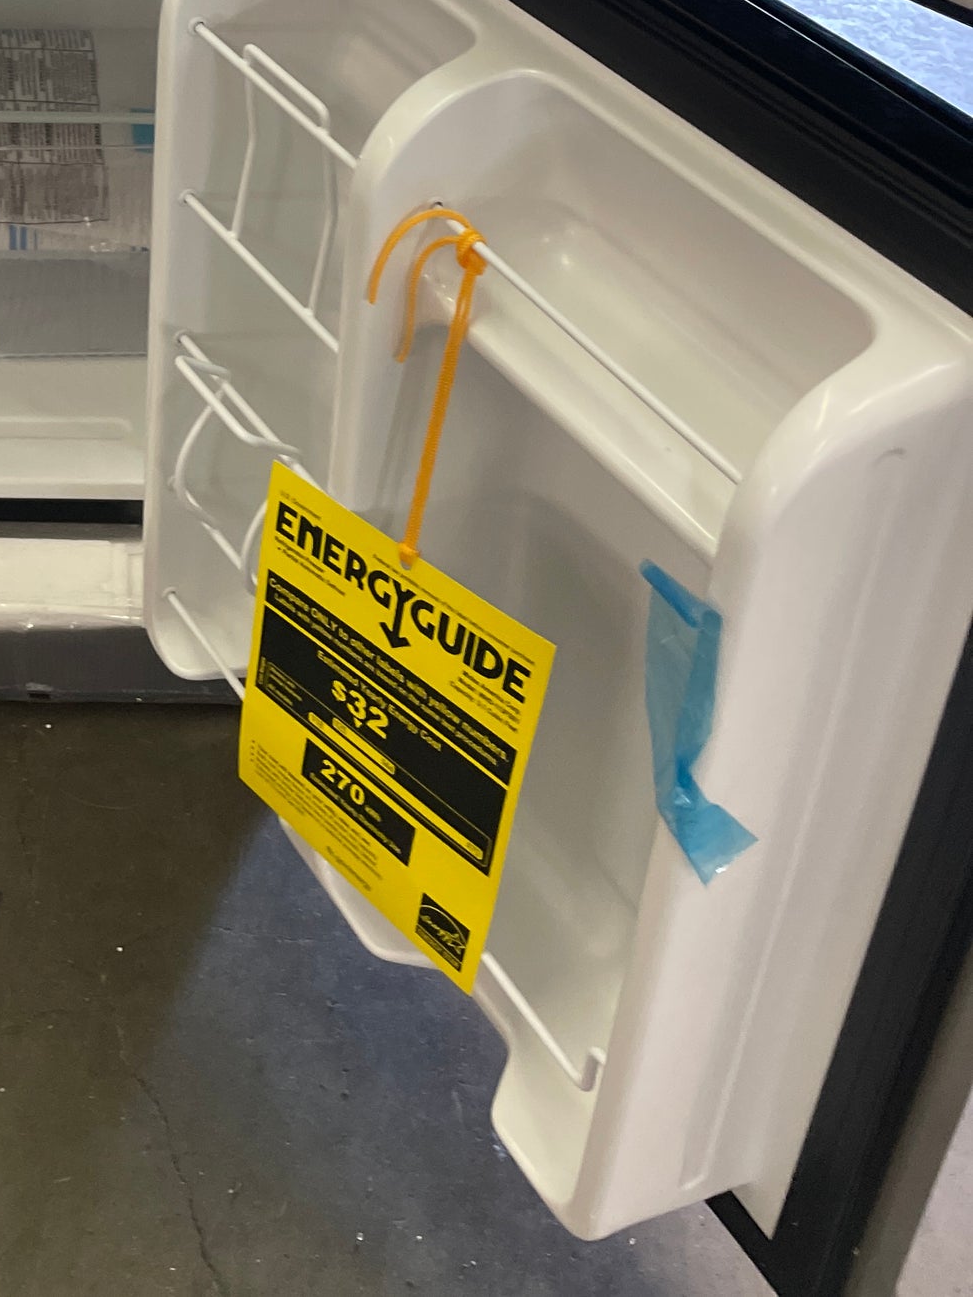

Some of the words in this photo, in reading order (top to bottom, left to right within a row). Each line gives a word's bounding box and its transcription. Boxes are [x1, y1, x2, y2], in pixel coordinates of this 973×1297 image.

[275, 501, 532, 704] ENERGYGUIDE
[310, 605, 337, 634] ONLY
[330, 679, 390, 740] $32
[320, 758, 366, 807] 270
